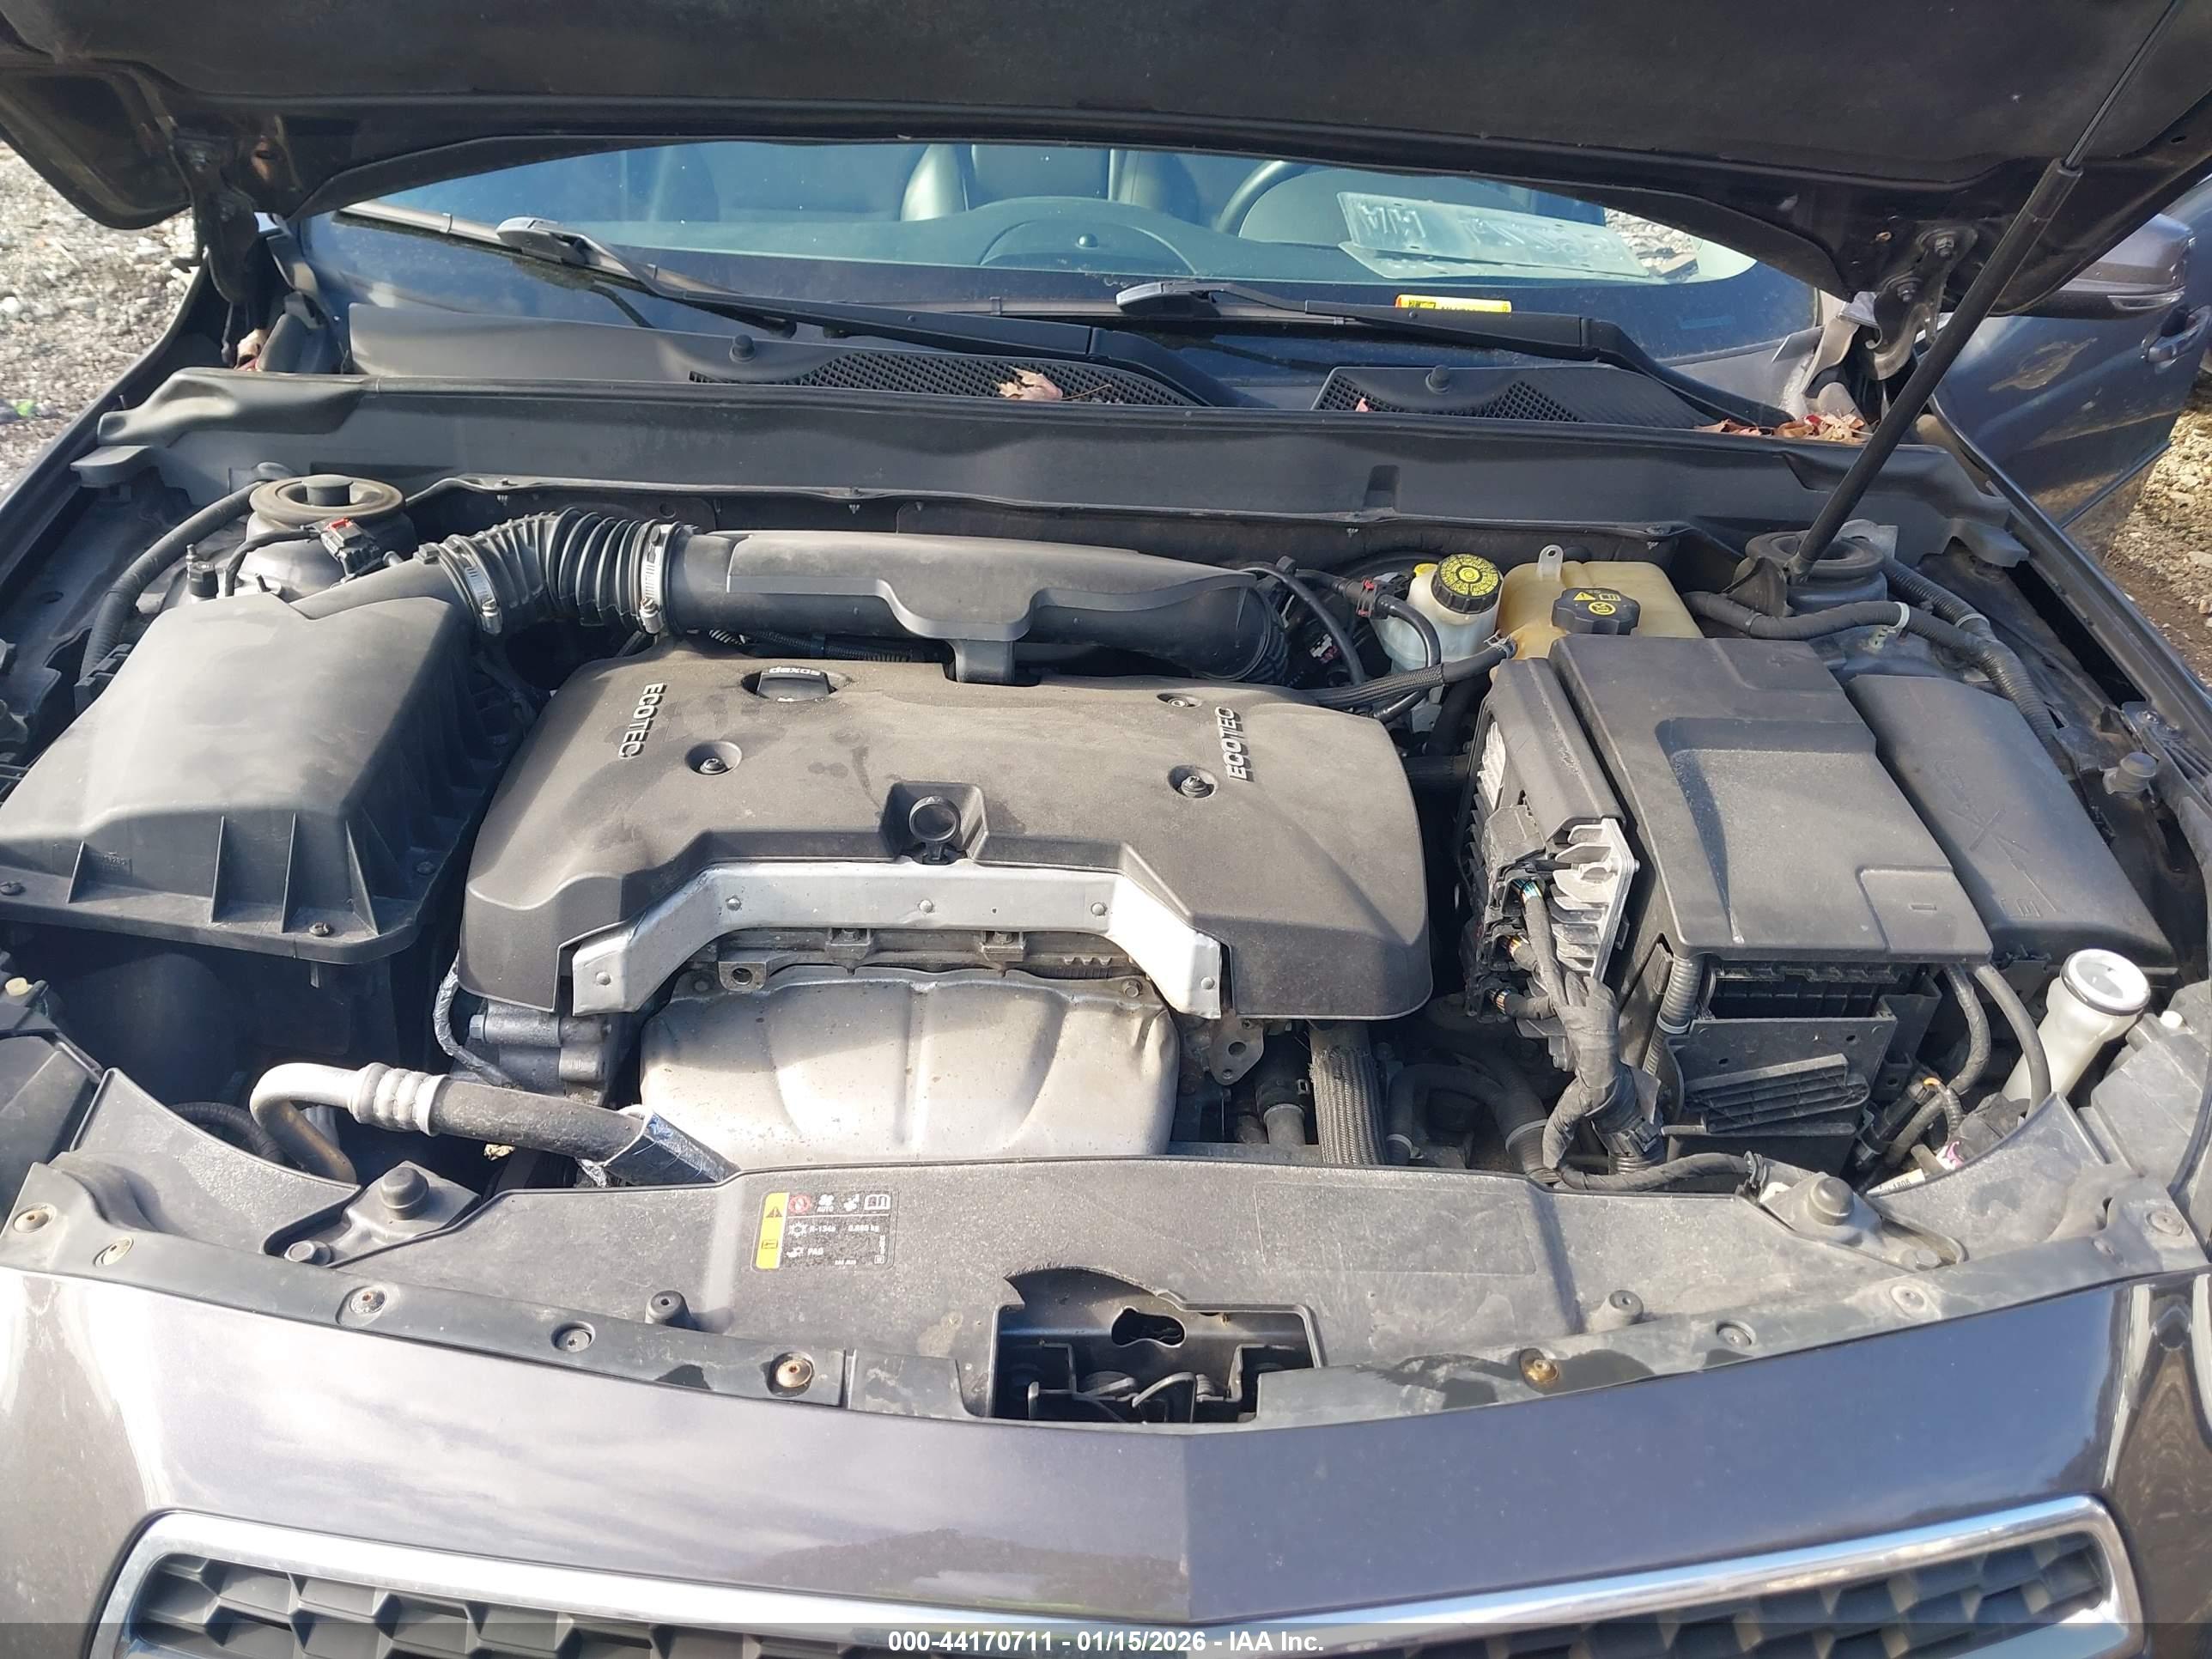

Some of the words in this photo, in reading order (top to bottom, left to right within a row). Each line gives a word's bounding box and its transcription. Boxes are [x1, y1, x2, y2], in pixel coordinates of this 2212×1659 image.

[769, 665, 822, 677] dexos
[617, 682, 665, 760] ECOTEC
[1214, 705, 1250, 781] ECOTEC
